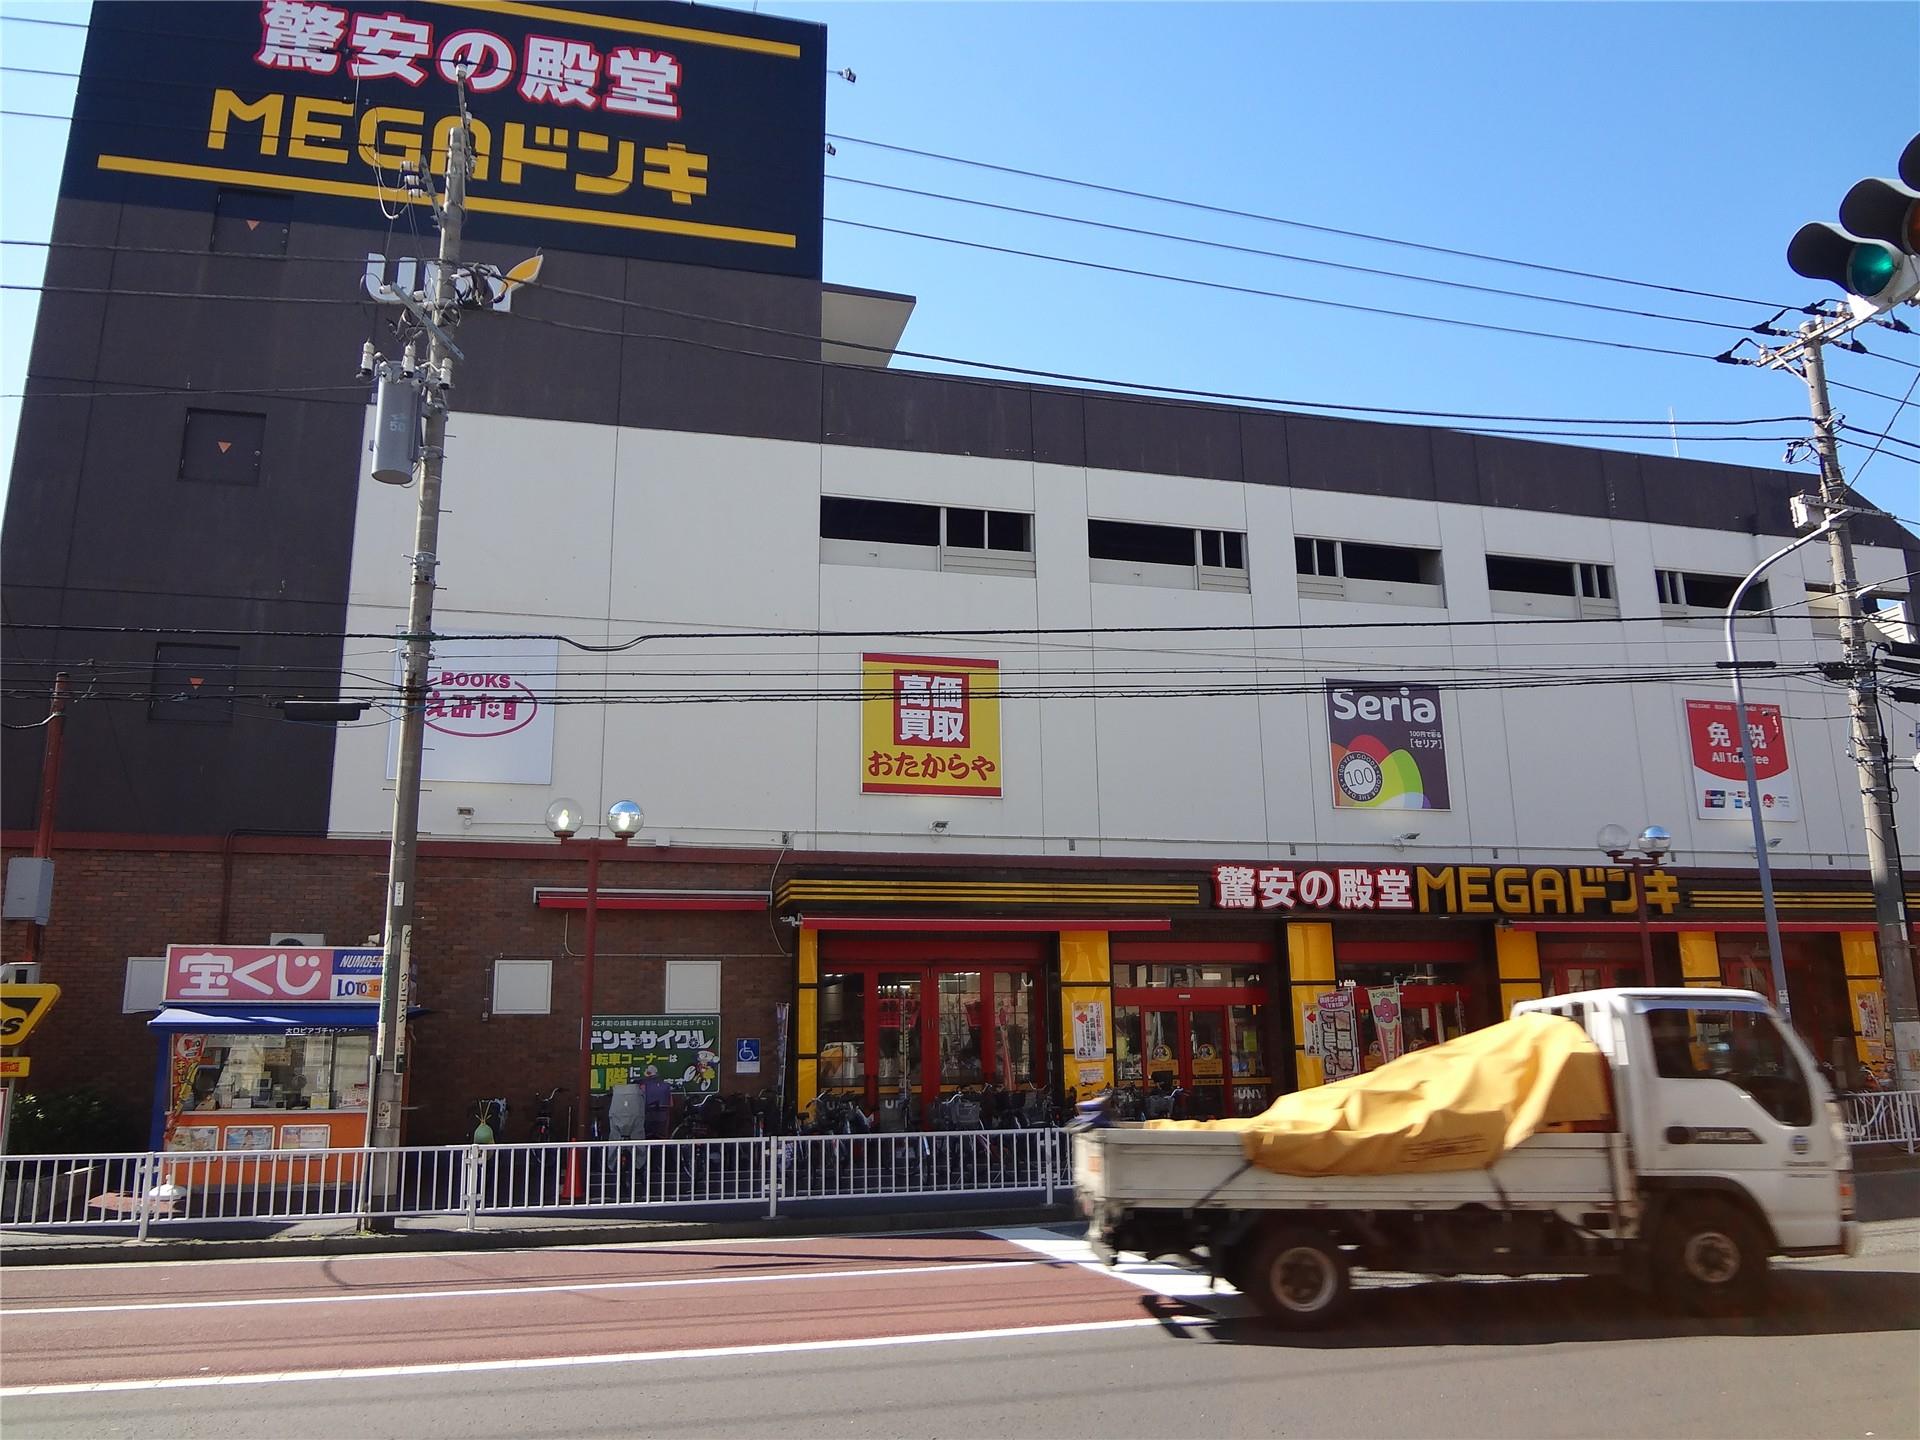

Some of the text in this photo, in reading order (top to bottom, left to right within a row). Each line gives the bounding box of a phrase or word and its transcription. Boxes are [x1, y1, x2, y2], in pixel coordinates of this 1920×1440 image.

[257, 0, 683, 119] 驚安の殿堂
[207, 89, 710, 205] MEGAドンキ
[441, 671, 511, 689] BOOKS
[899, 674, 963, 709] 高価
[1332, 686, 1437, 724] Seria
[899, 708, 965, 743] 買取
[867, 750, 997, 781] おたからや
[1345, 767, 1374, 788] 100
[1215, 865, 1680, 914] 驚安の殿堂 MEGAドンキ
[179, 952, 322, 997] 宝くじ
